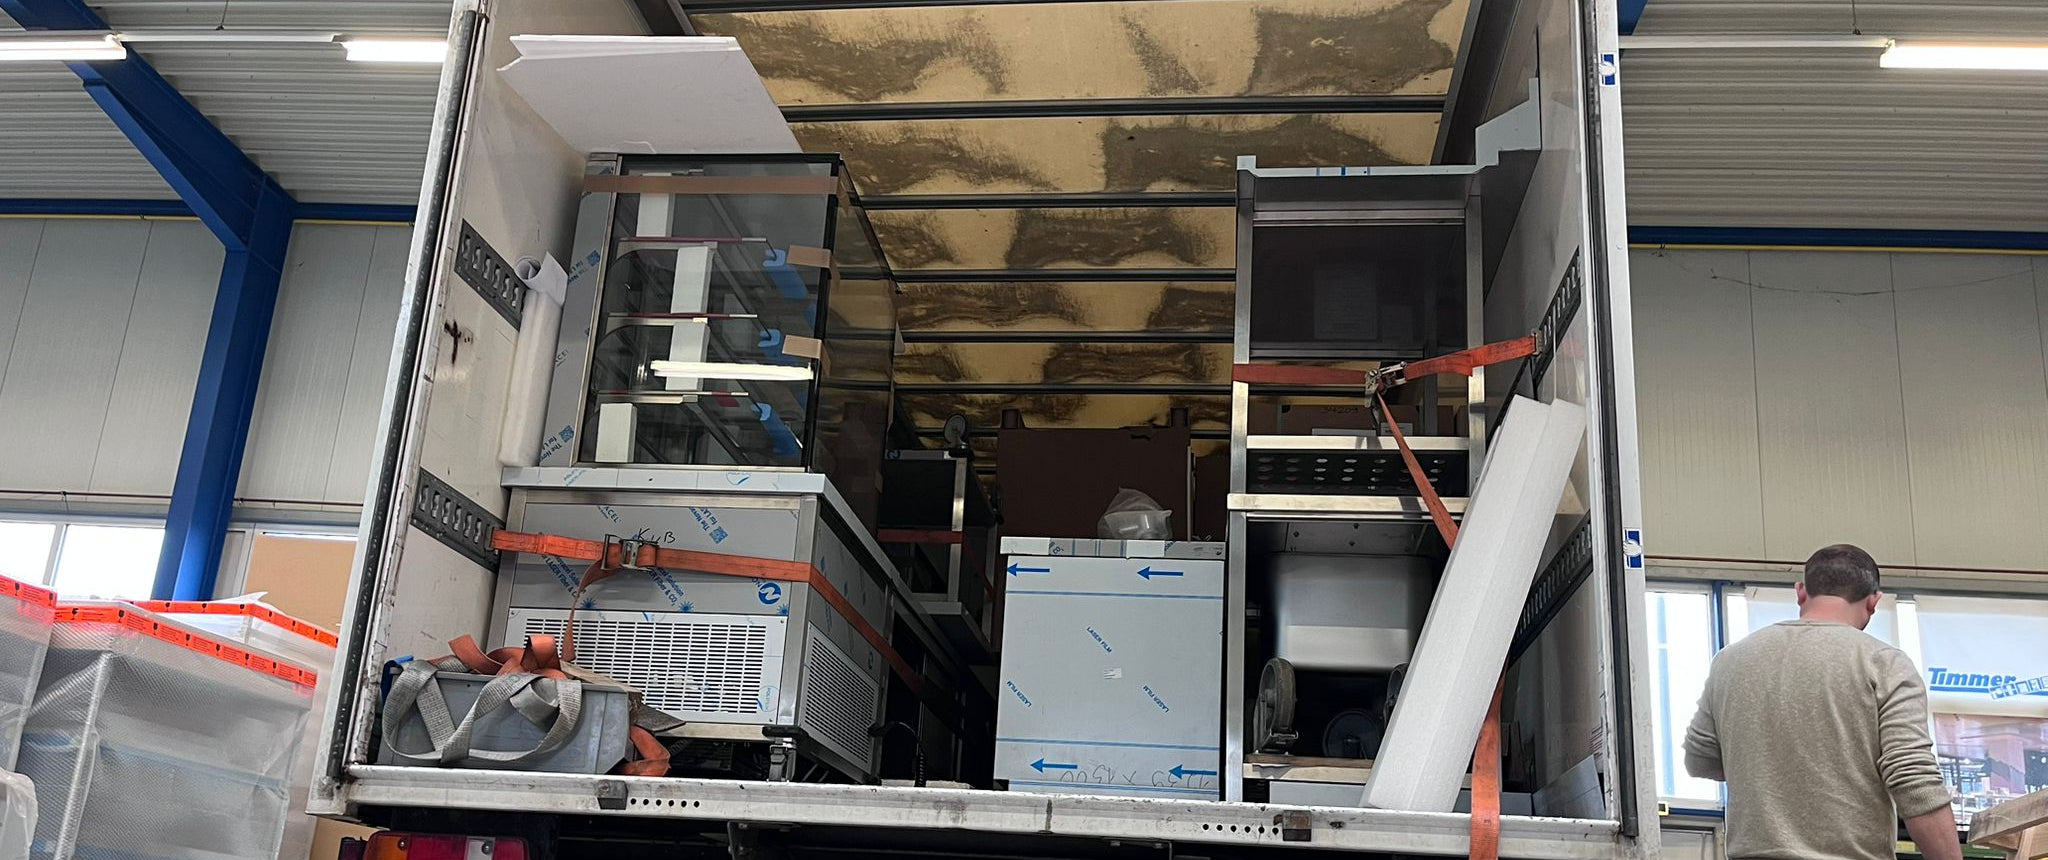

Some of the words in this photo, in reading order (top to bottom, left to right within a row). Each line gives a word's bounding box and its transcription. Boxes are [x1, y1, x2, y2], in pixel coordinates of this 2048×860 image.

[1086, 626, 1103, 643] LASER
[1100, 640, 1113, 653] FILM
[1928, 667, 2017, 687] Timmer
